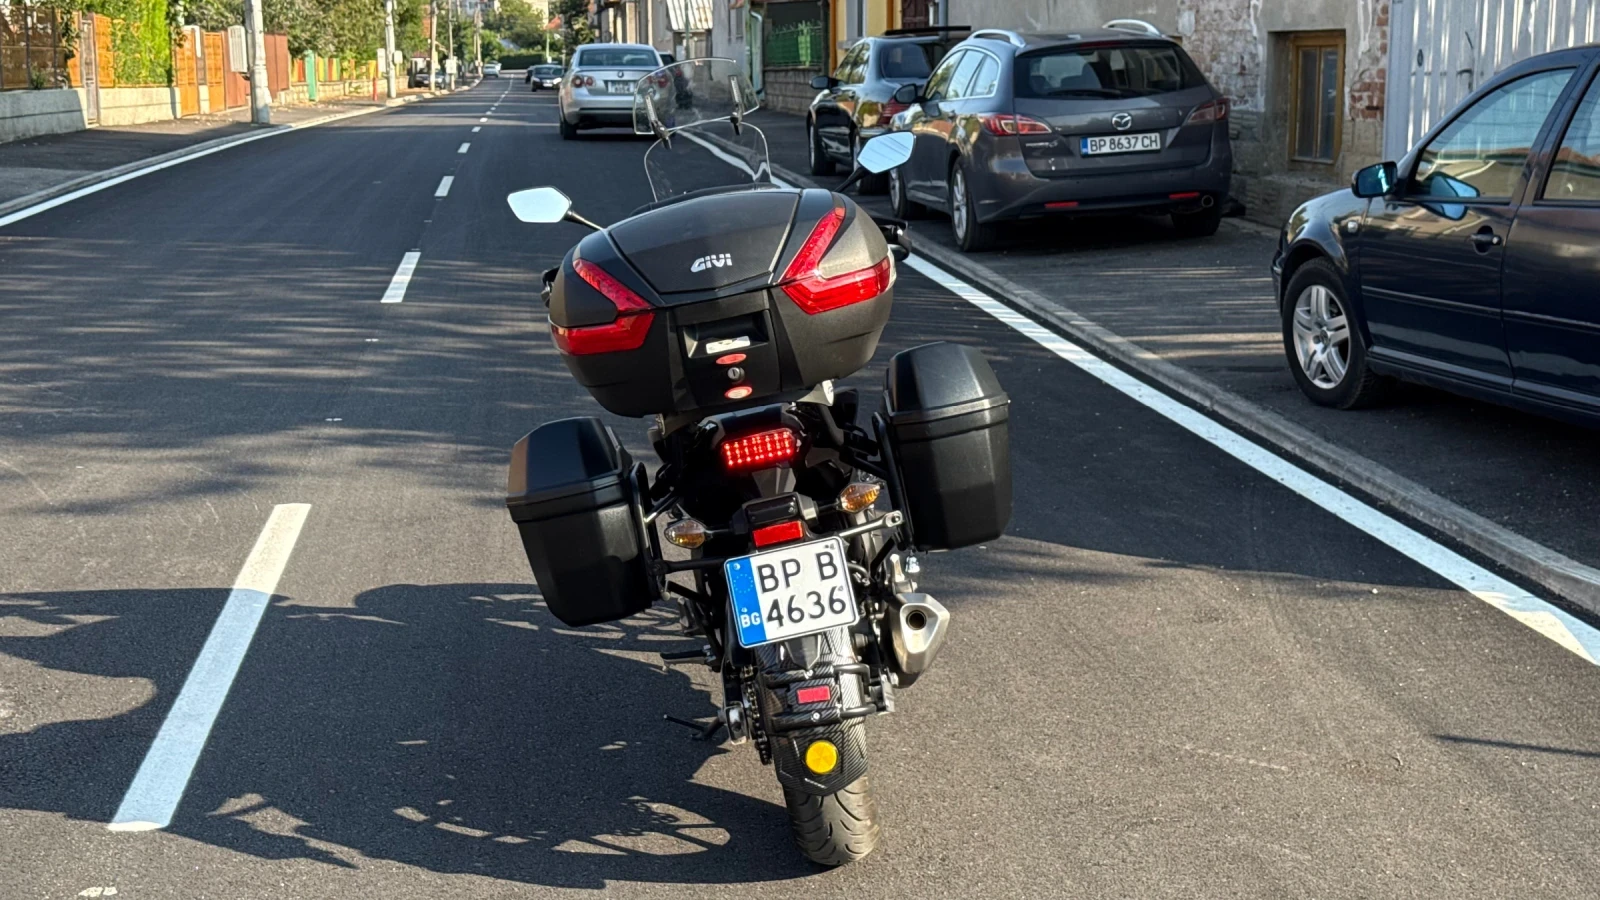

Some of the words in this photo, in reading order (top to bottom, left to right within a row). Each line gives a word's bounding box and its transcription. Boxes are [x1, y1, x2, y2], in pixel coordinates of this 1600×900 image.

[1090, 138, 1107, 152] BP
[1109, 136, 1139, 151] 8637
[1141, 134, 1158, 148] CH
[690, 253, 733, 272] GIVI
[757, 558, 801, 594] BP
[815, 551, 838, 581] B
[766, 586, 846, 628] 4636
[740, 613, 761, 628] BG
